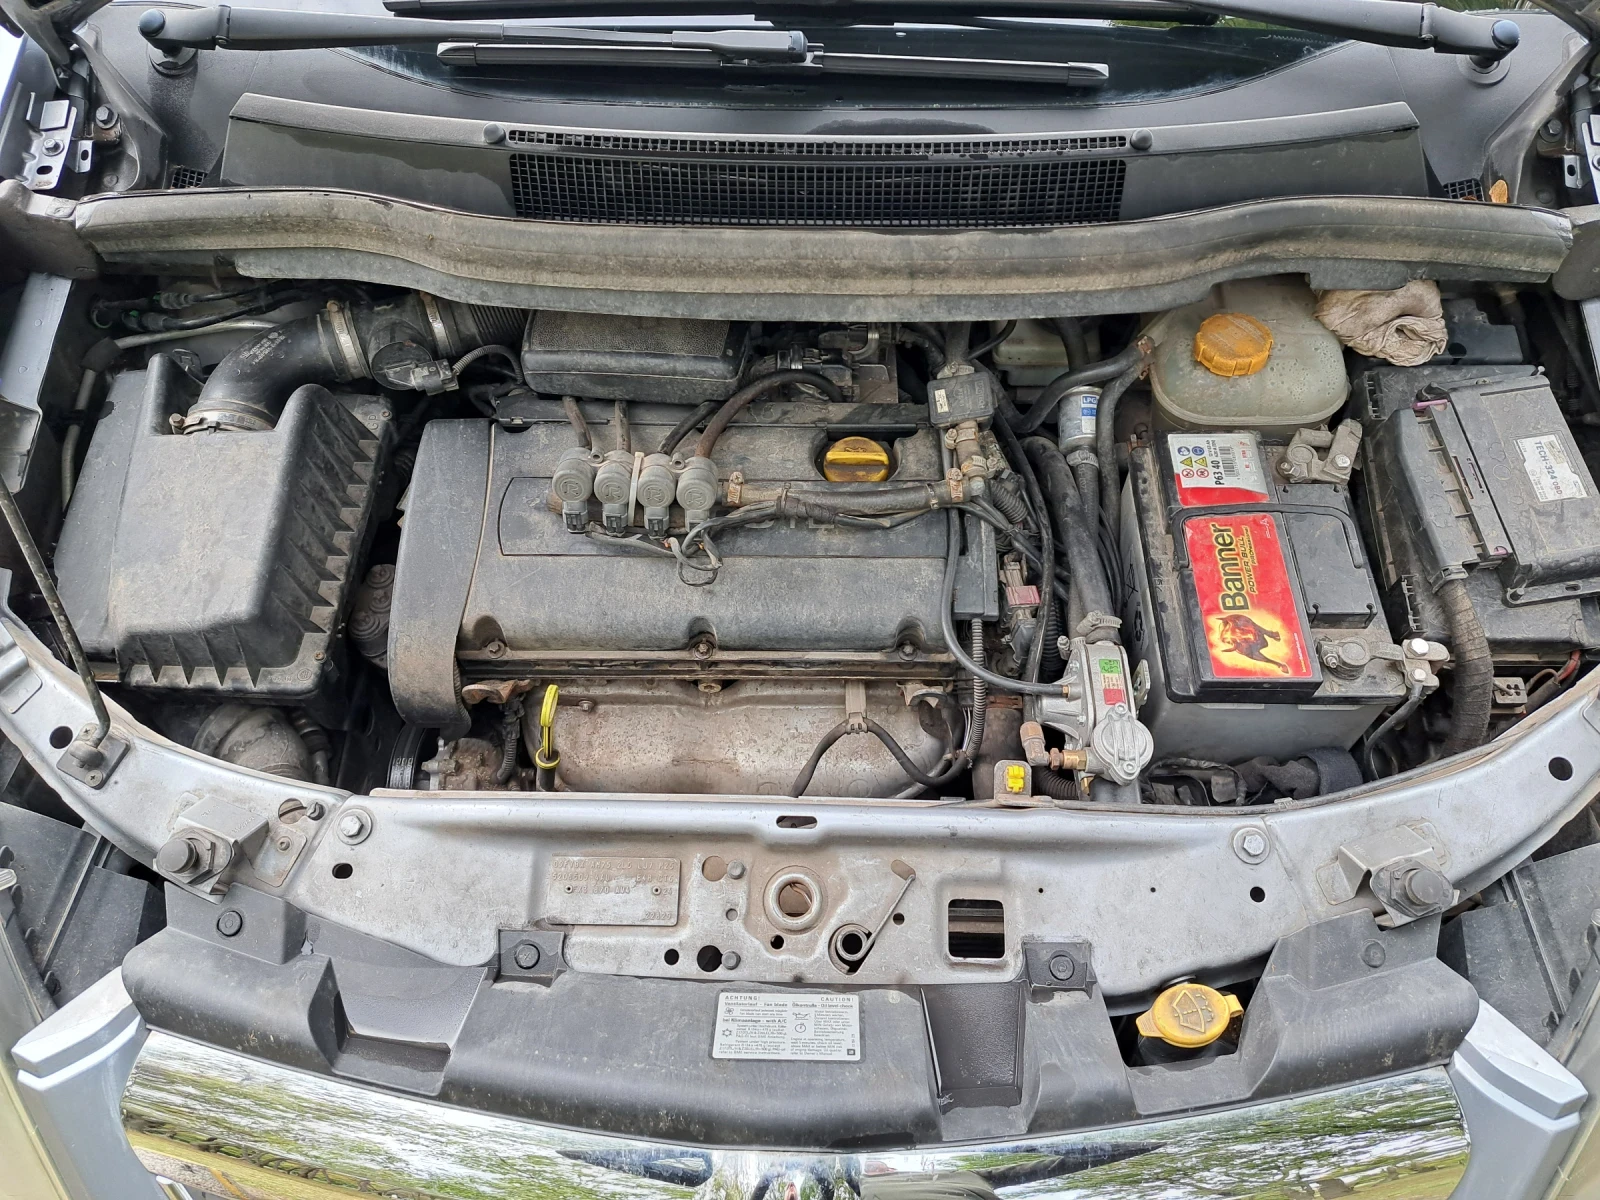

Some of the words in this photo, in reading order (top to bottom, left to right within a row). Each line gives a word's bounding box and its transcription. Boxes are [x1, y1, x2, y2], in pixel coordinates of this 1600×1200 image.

[1083, 396, 1097, 404] LPG
[1211, 460, 1222, 470] 40
[1534, 440, 1558, 481] TECH-324
[1213, 472, 1225, 485] P63
[1237, 536, 1248, 560] BULL
[1211, 522, 1250, 612] Banner
[1243, 559, 1257, 594] POWER
